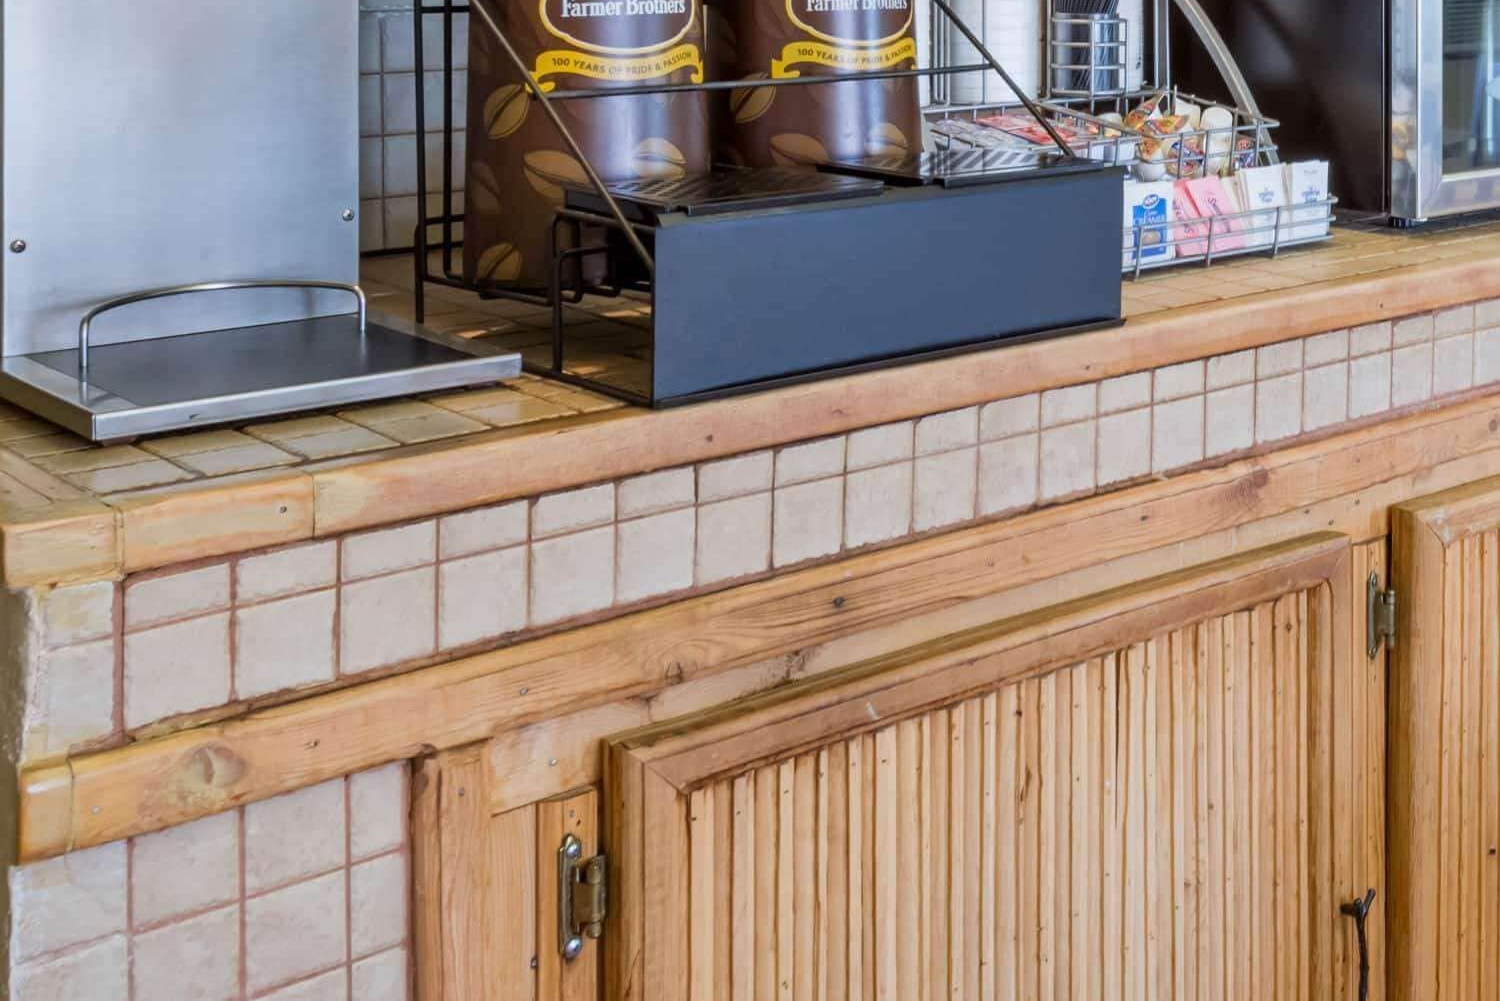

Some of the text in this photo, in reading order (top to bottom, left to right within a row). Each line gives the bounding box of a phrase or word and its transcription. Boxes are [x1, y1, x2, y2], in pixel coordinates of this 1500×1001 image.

[797, 48, 814, 57] 100
[552, 57, 570, 67] 100
[573, 59, 606, 74] YEARS
[663, 51, 692, 68] PASSION
